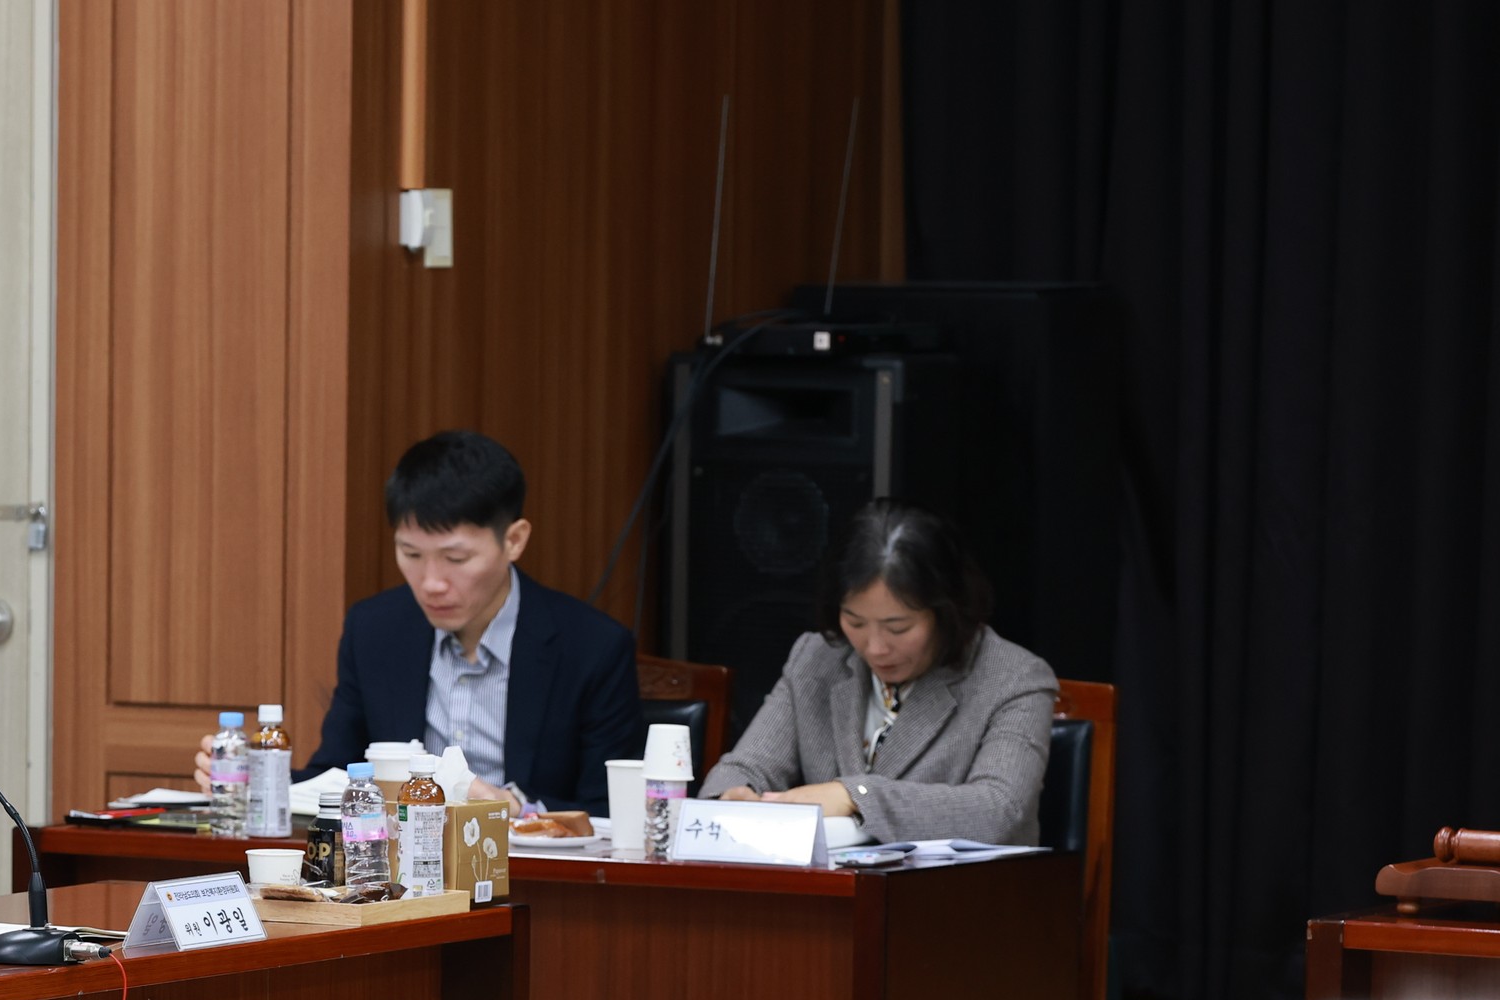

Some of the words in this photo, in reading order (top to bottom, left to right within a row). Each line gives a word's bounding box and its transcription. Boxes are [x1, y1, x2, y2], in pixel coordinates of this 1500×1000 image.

[174, 889, 202, 901] 전라남도의회
[201, 884, 241, 897] 보건복지환경위원회
[185, 921, 202, 936] 위원
[203, 907, 249, 936] 이광일
